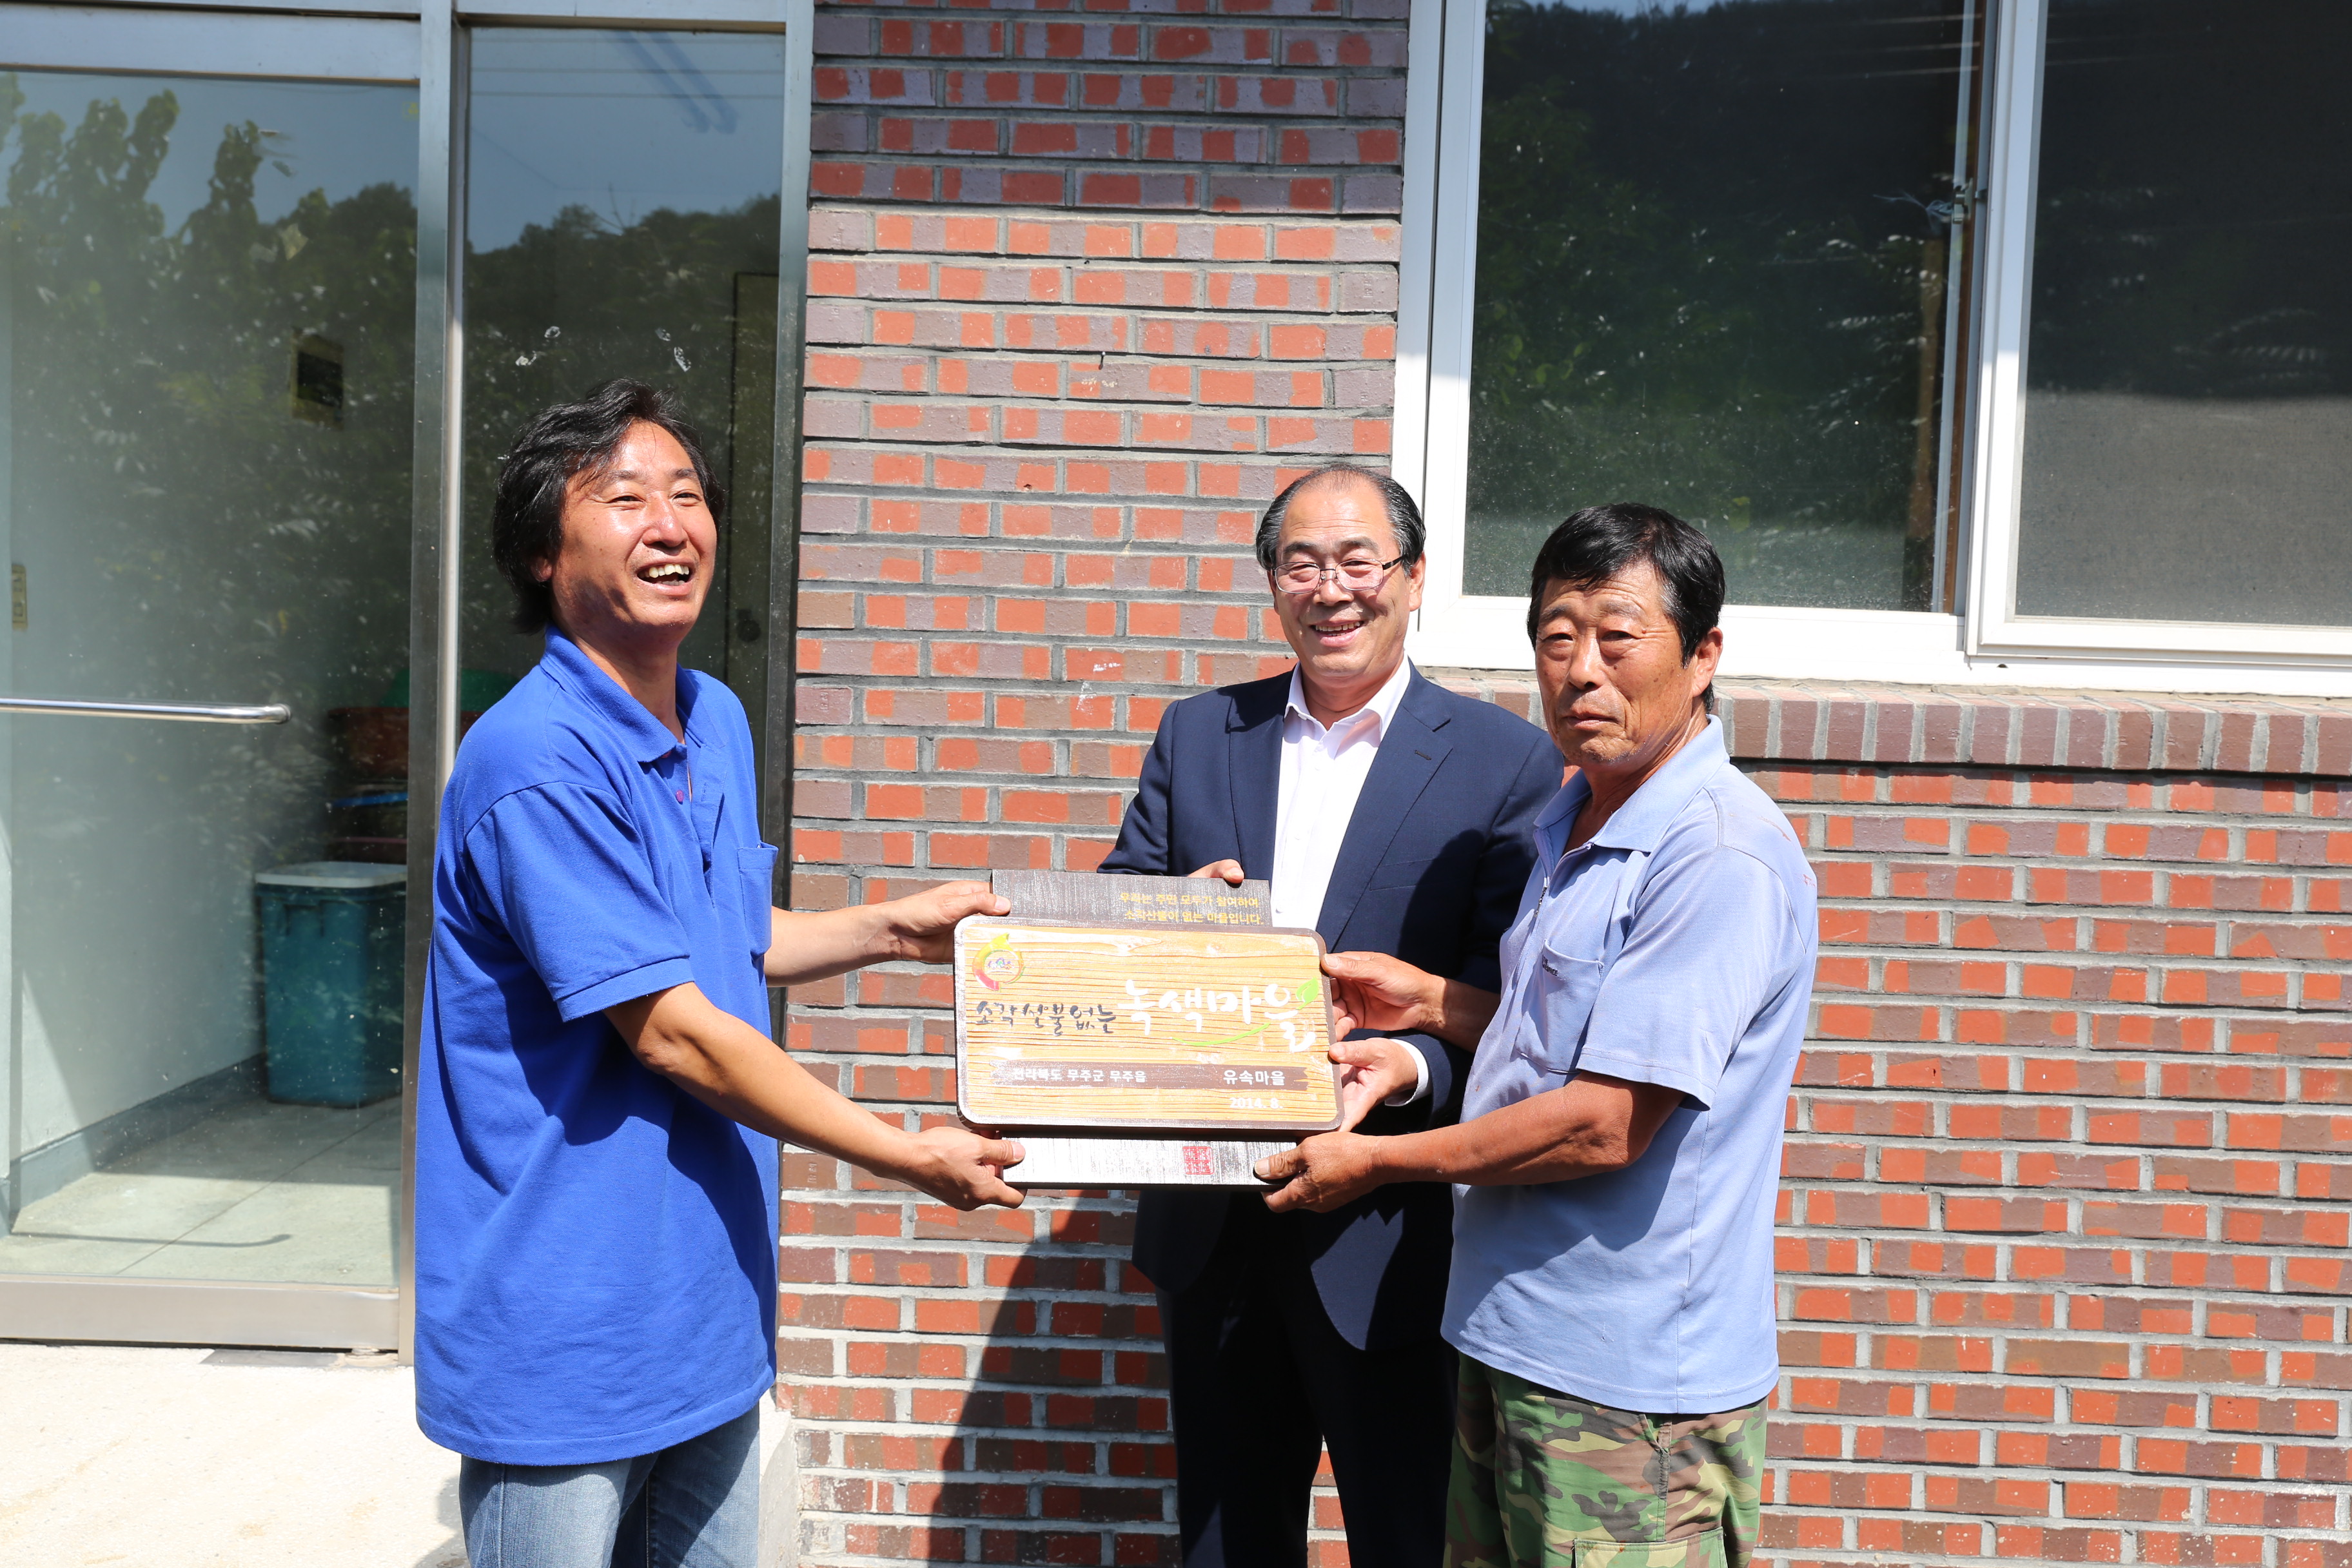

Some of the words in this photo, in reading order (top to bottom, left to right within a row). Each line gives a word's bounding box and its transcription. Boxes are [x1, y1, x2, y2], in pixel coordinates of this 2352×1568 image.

[1120, 892, 1152, 904] 우리는
[1156, 894, 1178, 905] 주민
[1181, 894, 1213, 906] 모두가
[1216, 896, 1259, 908] 참여하여
[1124, 910, 1179, 922] 소각산불이
[1182, 912, 1204, 923] 없는
[1207, 913, 1264, 925] 마을입니다.
[1117, 979, 1317, 1052] 녹색마을
[1013, 1068, 1063, 1081] 전라북도
[1067, 1069, 1104, 1082] 무주군
[1110, 1070, 1146, 1083] 무주읍
[1223, 1070, 1285, 1086] 유속마을
[1229, 1097, 1267, 1109] 2014.
